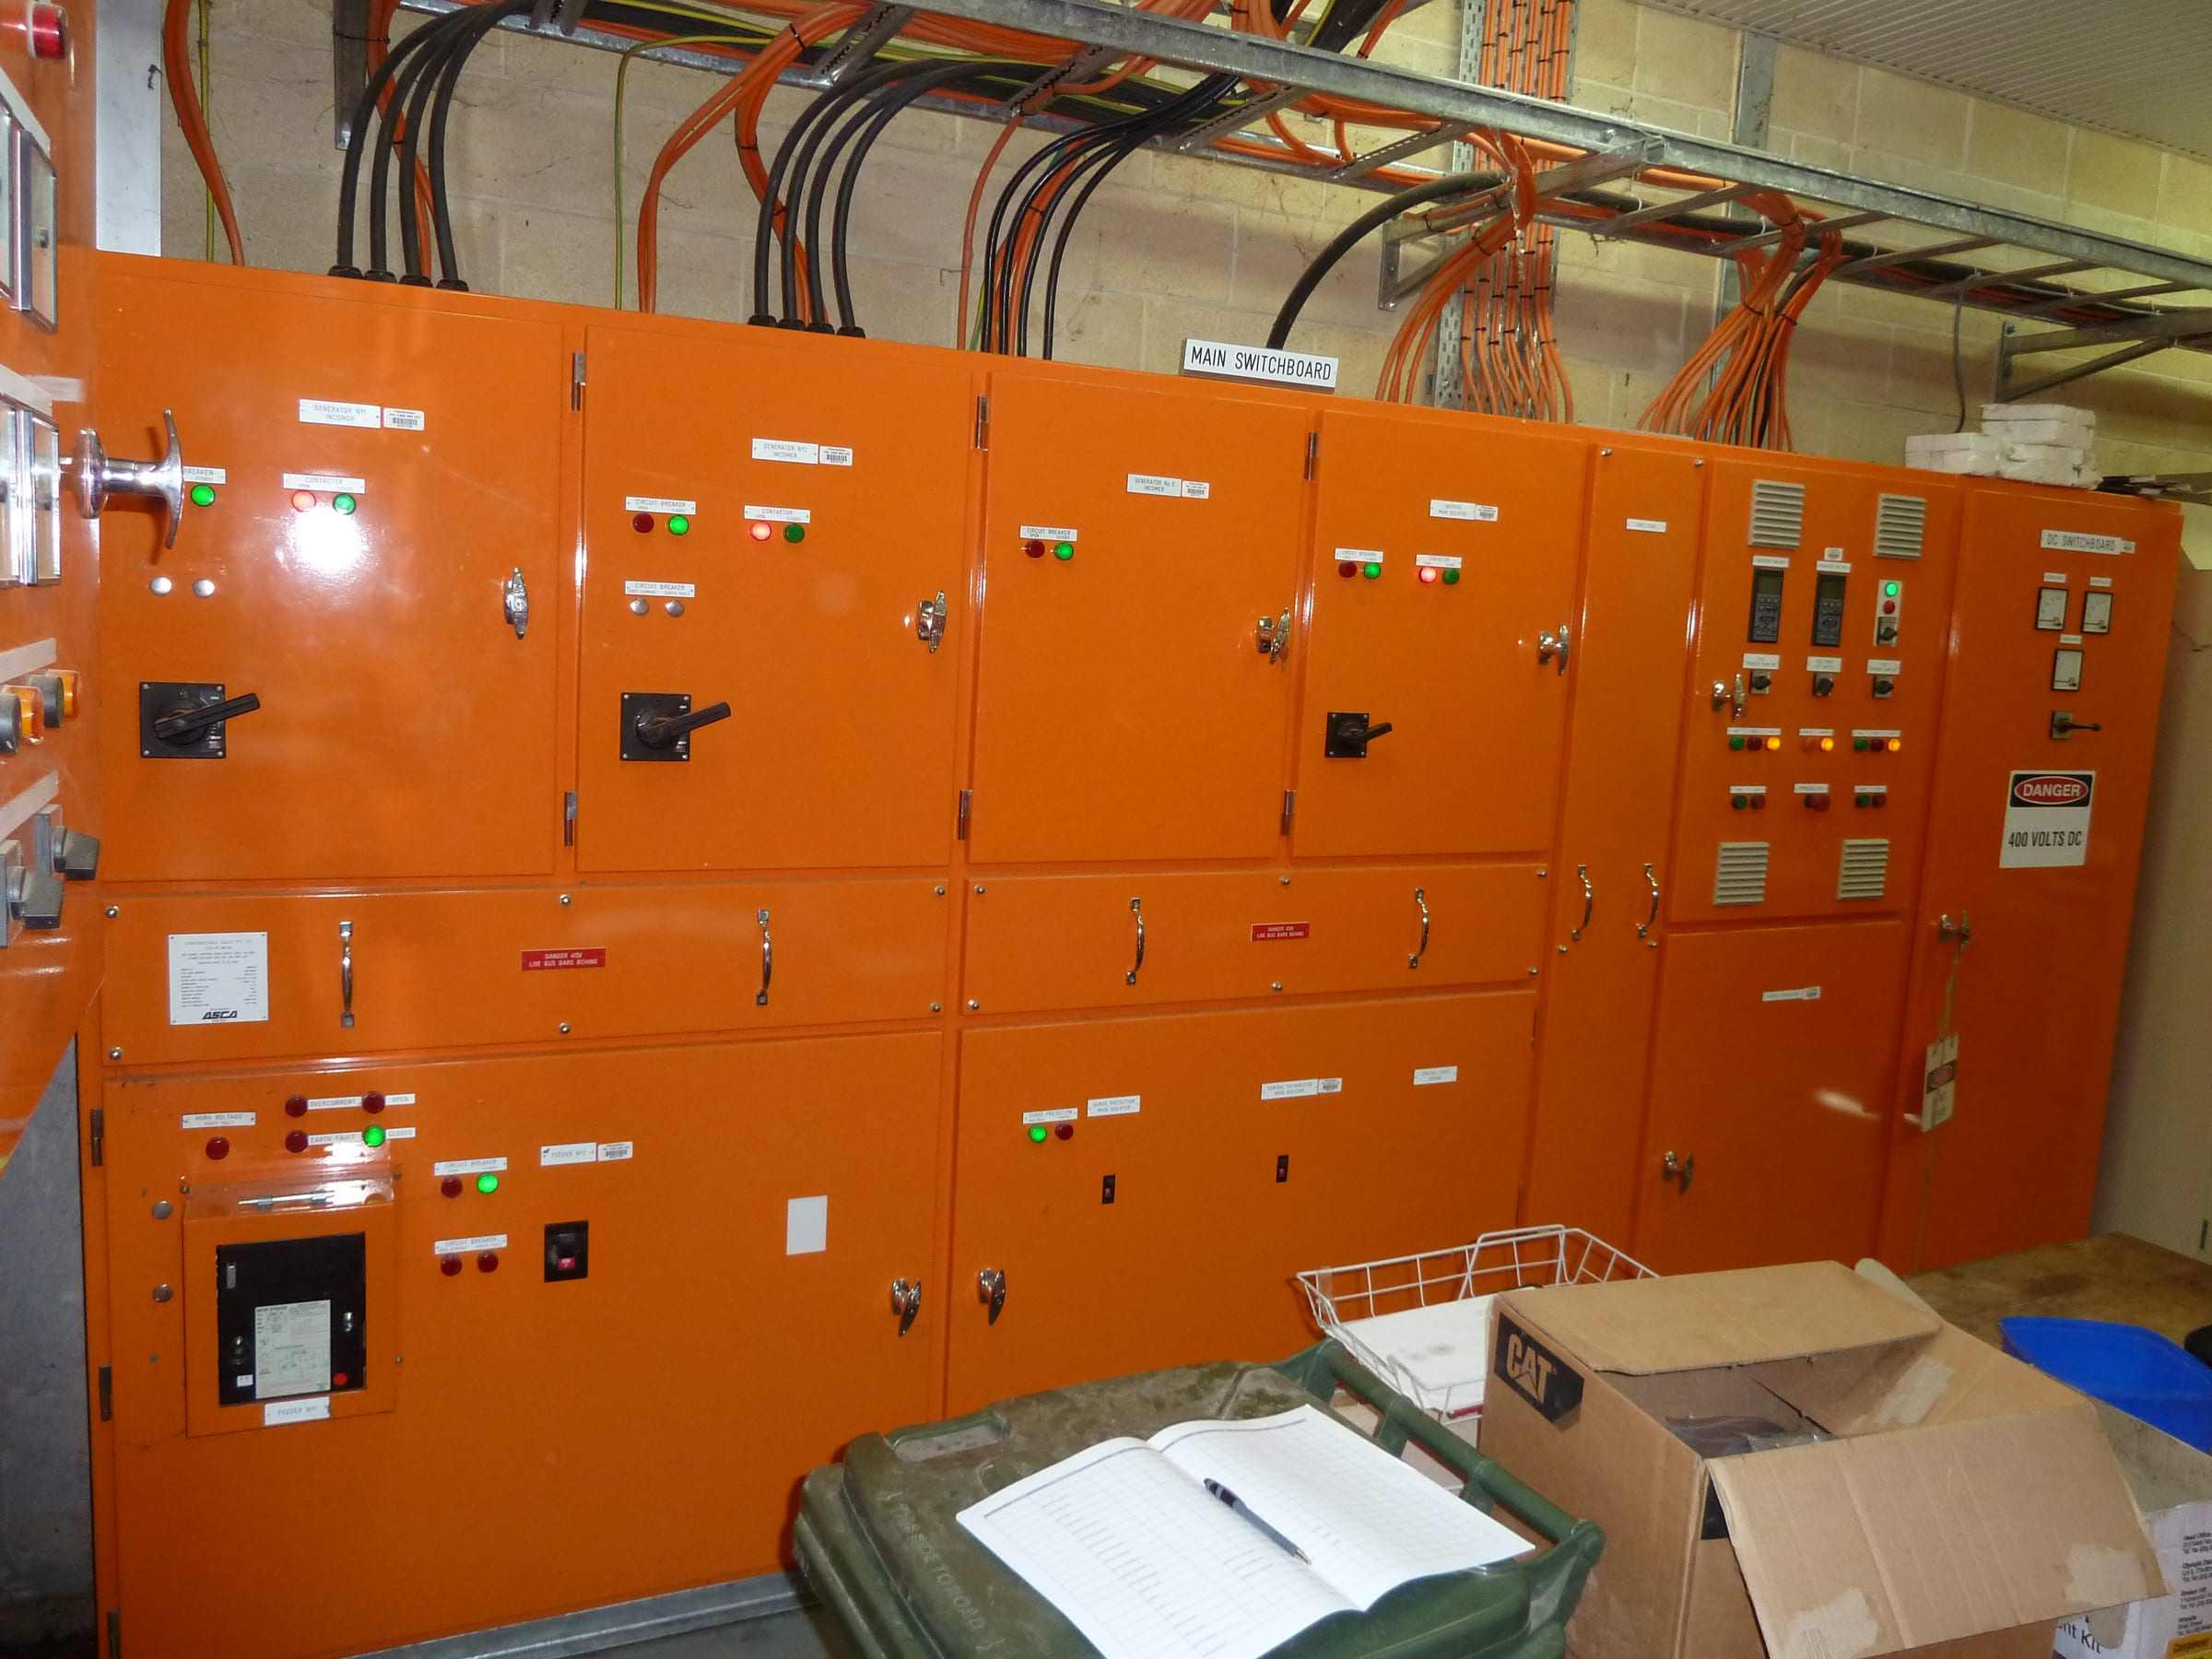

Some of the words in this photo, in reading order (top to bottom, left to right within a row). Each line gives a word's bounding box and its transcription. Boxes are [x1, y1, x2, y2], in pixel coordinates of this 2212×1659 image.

[1191, 346, 1227, 369] MAIN
[1234, 352, 1333, 382] SWITCHBOARD
[2047, 533, 2059, 546] DC
[2063, 534, 2116, 552] SWITCHBOARD
[2022, 783, 2081, 797] DANGER
[2008, 831, 2029, 847] 400
[2031, 831, 2066, 847] VOLTS
[2067, 830, 2083, 846] DC
[202, 1010, 238, 1020] ASCA
[311, 1135, 332, 1144] EARTH
[1507, 1333, 1553, 1405] CAT
[2057, 1622, 2077, 1639] nt
